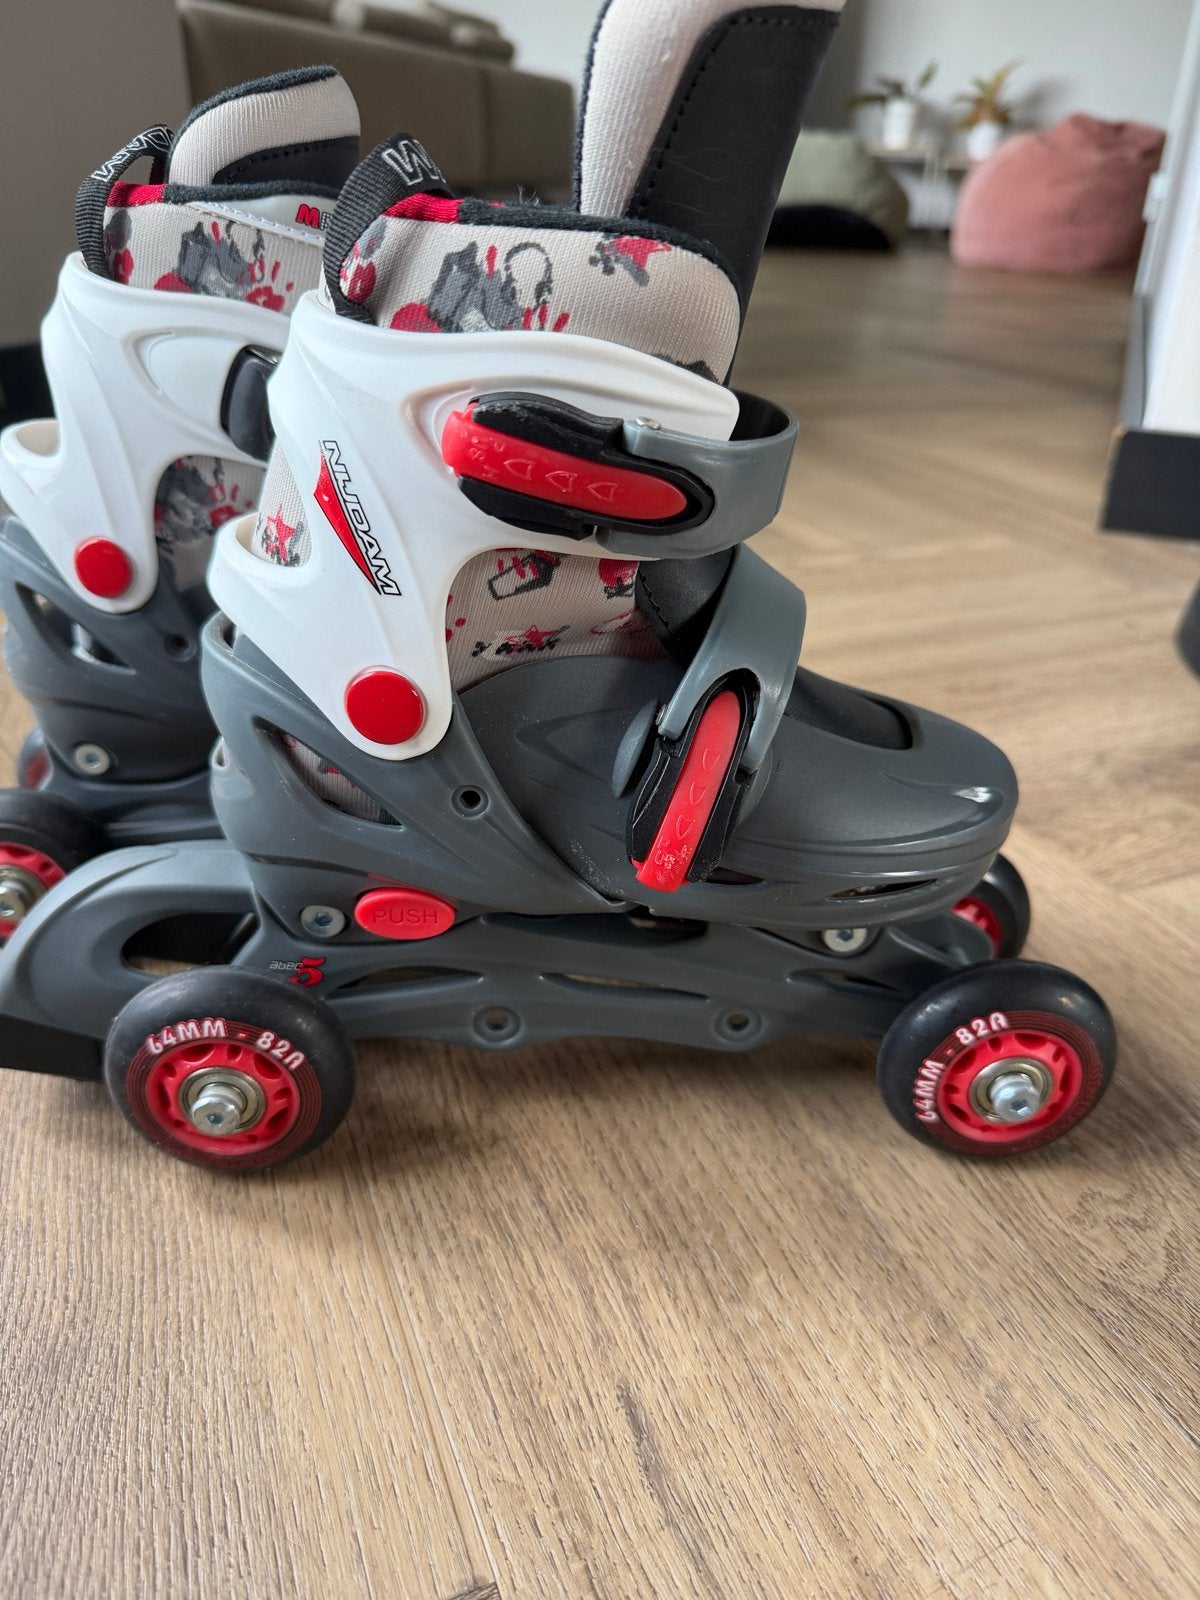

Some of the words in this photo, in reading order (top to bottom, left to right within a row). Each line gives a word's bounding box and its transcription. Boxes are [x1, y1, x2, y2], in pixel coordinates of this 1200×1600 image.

[322, 440, 402, 596] NIJDAM
[371, 908, 439, 925] PUSH
[146, 1017, 227, 1056] 64MM
[255, 1031, 306, 1071] 82A
[914, 1059, 947, 1124] 64MM
[955, 1011, 1009, 1046] 82A
